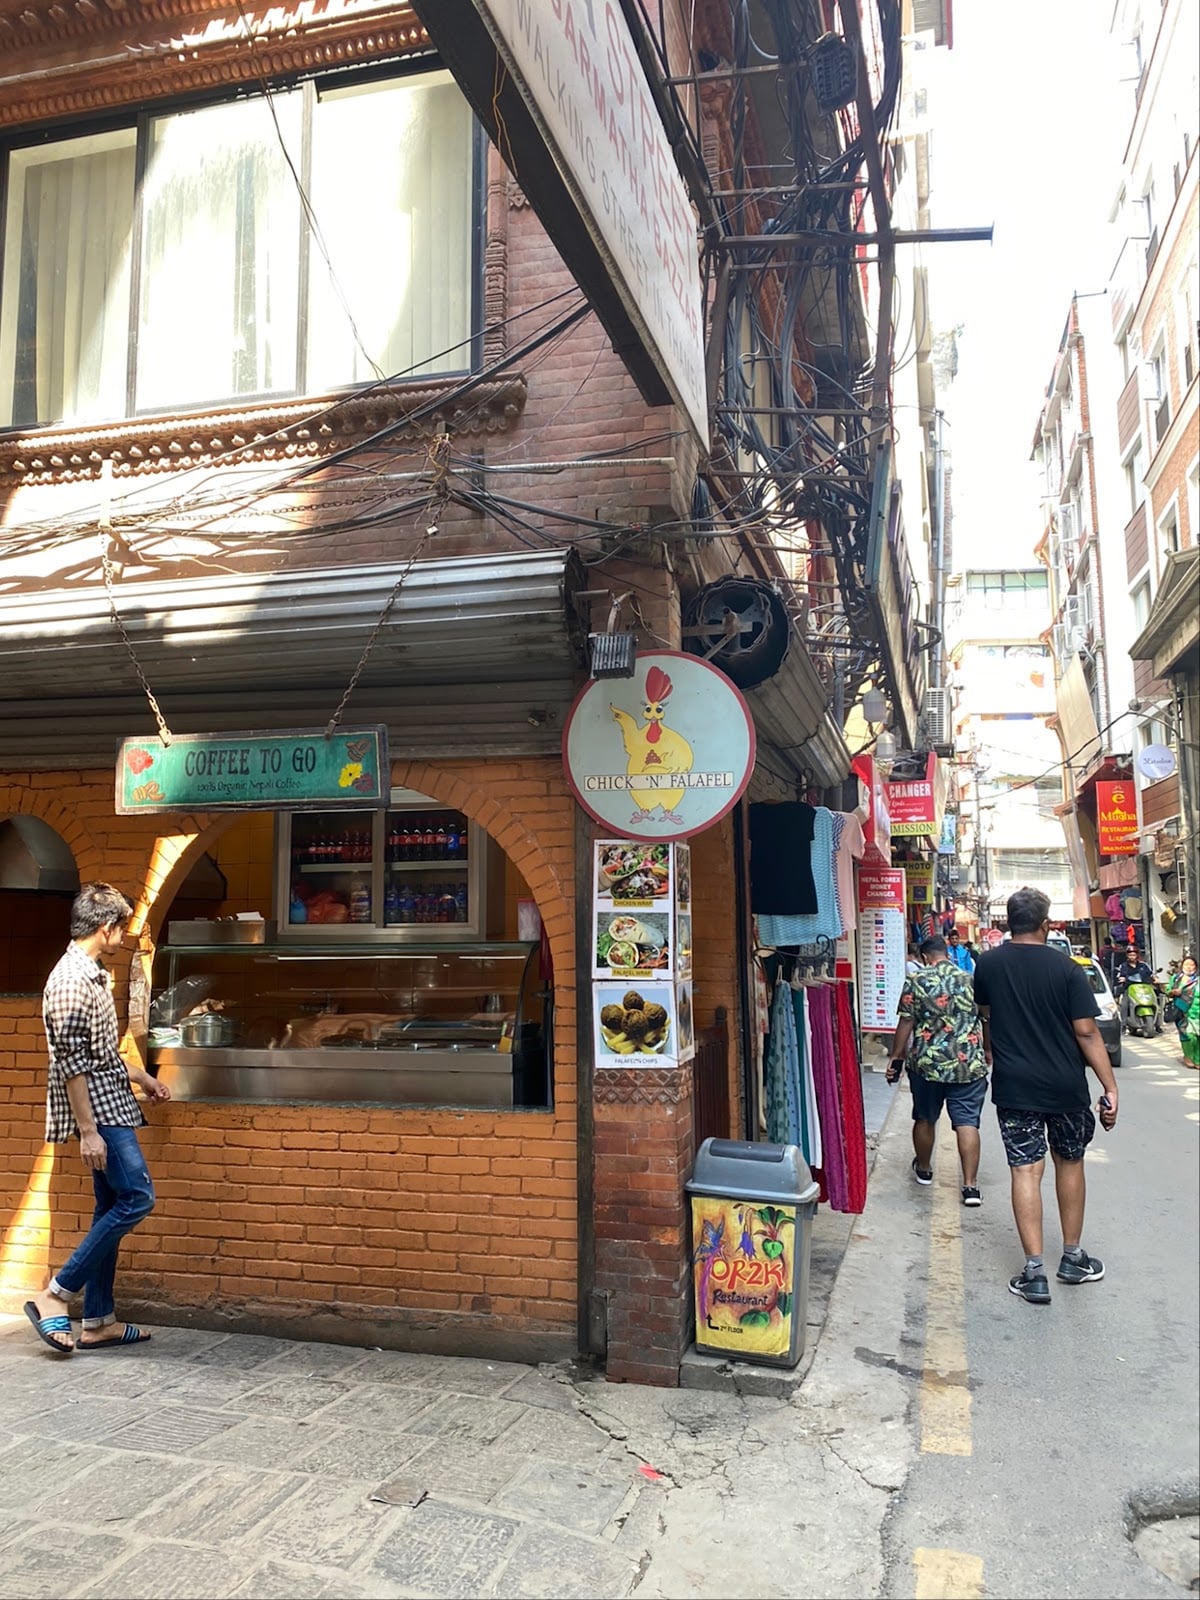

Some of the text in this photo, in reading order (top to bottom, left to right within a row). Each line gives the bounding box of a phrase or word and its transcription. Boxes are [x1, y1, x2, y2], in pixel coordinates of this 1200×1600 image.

[517, 0, 596, 183] WALKING
[601, 169, 650, 297] STREET
[185, 746, 316, 777] COFFEE TO GO
[217, 781, 247, 795] Organic
[249, 779, 274, 793] Nepali
[275, 778, 302, 790] Coffee
[586, 776, 634, 790] CHICK
[670, 773, 732, 787] FALAFEL
[889, 783, 931, 798] CHANGER
[1101, 811, 1137, 822] Mugha
[891, 824, 933, 834] MISSION
[904, 862, 931, 870] PHOTO
[709, 1258, 785, 1291] OR2K
[712, 1289, 769, 1307] Restaurant
[728, 1326, 744, 1334] FLOOR
